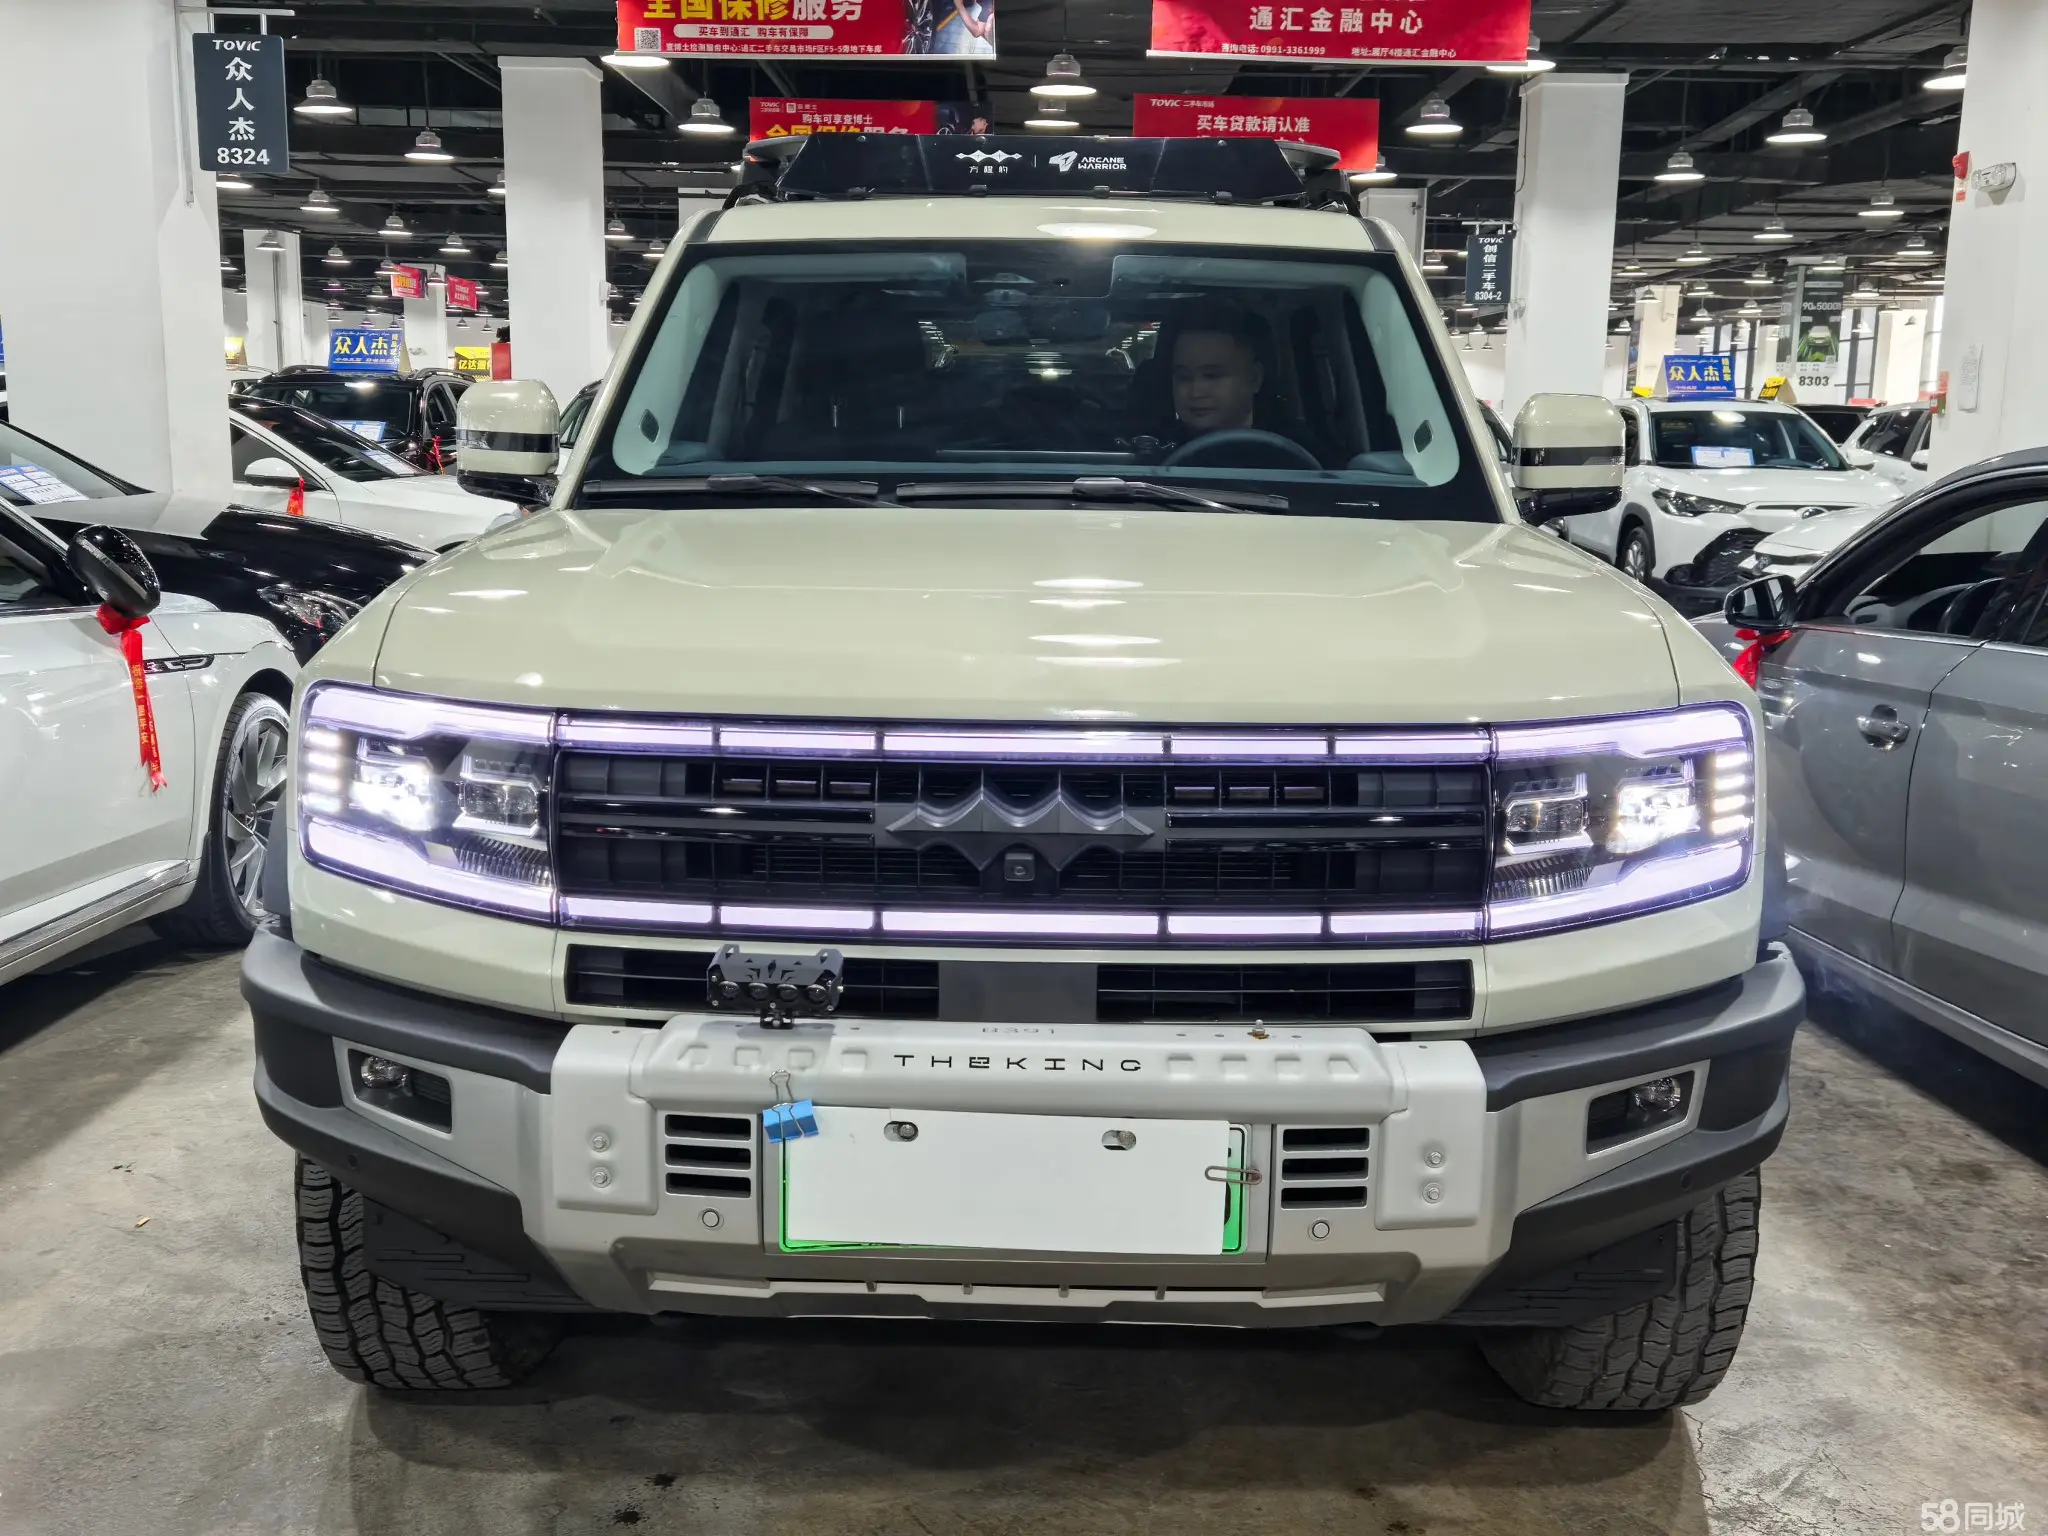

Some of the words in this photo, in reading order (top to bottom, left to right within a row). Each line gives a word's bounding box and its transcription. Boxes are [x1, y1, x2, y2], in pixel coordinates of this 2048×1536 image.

[1249, 5, 1424, 35] 通汇金融中心
[698, 26, 750, 37] 买车到通汇
[757, 26, 809, 38] 购车有保障
[212, 39, 262, 51] TOVIC
[1261, 44, 1326, 56] 0991-3361999
[225, 56, 255, 141] 众人杰
[1150, 98, 1182, 107] TOVIC
[1196, 114, 1311, 133] 买车贷款请认准
[217, 147, 270, 165] 8324
[1081, 156, 1125, 164] ARCANE
[1482, 244, 1498, 291] 创信二手车
[1474, 291, 1502, 301] 8304-2
[333, 335, 389, 355] 众人杰
[1669, 365, 1720, 382] 众人杰
[1798, 375, 1830, 387] 8303
